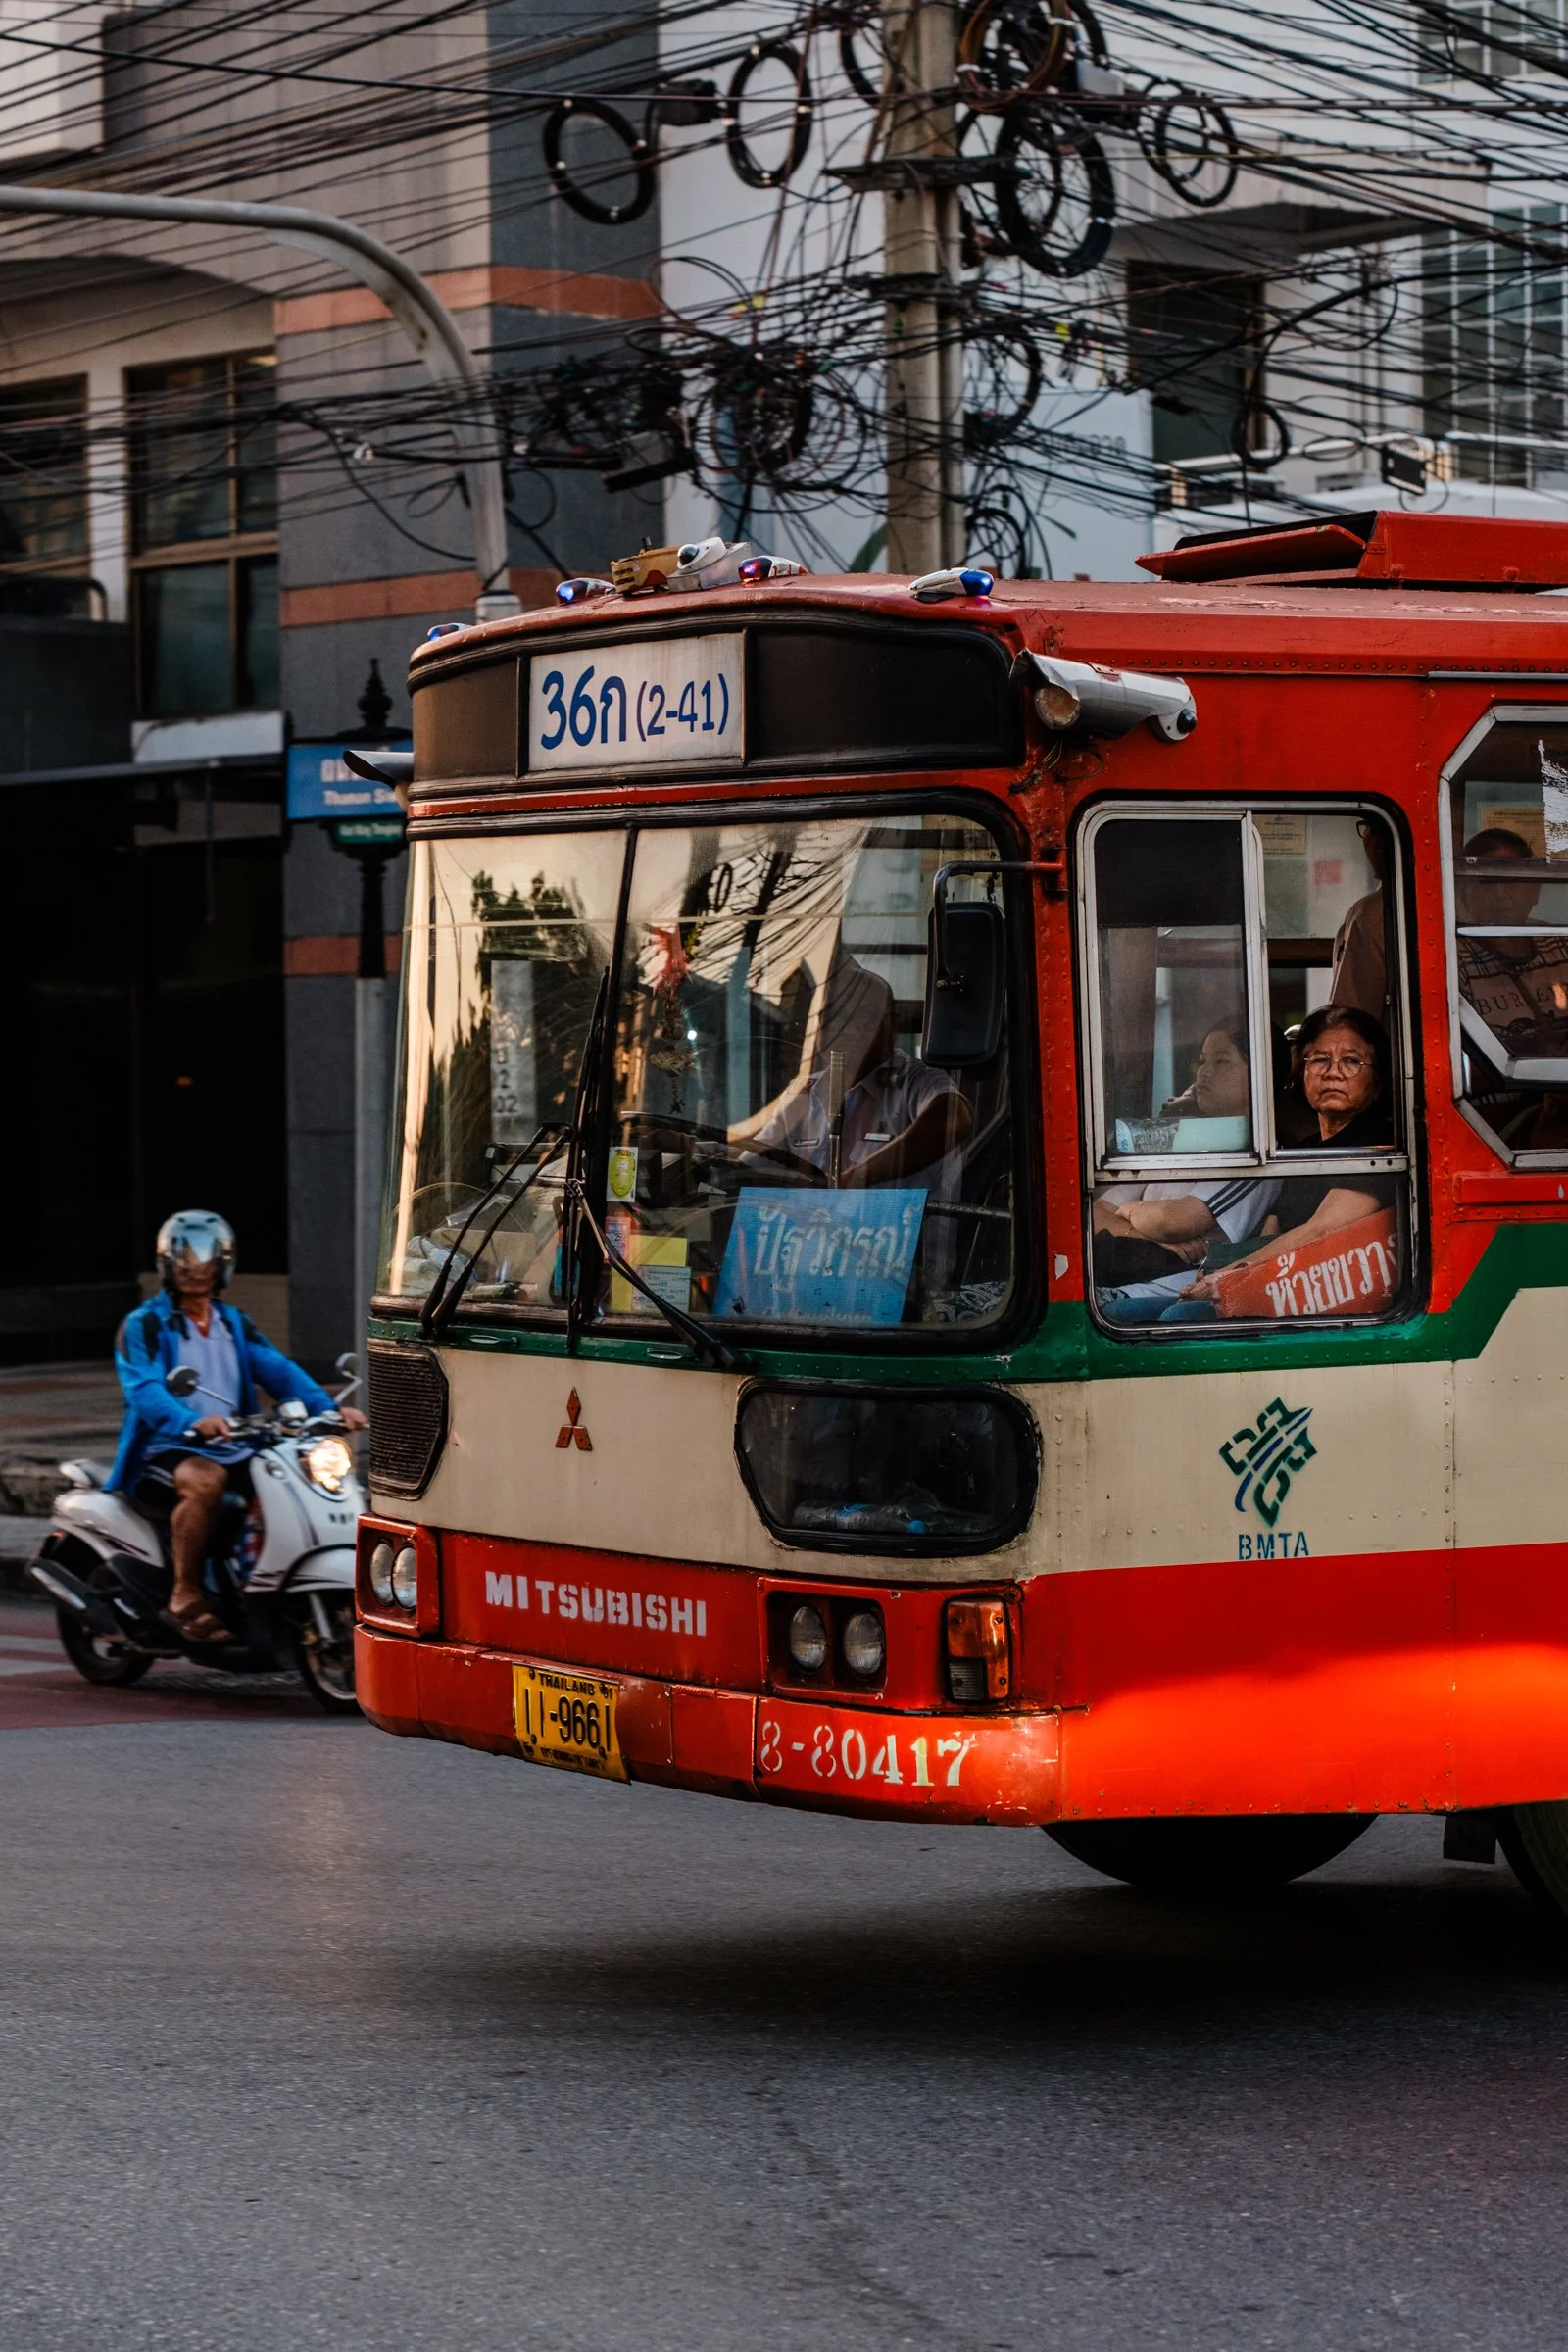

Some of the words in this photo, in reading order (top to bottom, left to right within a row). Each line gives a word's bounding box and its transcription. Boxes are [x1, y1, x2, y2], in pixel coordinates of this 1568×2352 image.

[540, 664, 627, 750] 36ก
[636, 673, 729, 742] (2-41)
[1238, 1531, 1309, 1560] BMTA
[485, 1571, 707, 1637] MITSUBISHI
[538, 1672, 596, 1696] THAILAND
[524, 1688, 612, 1752] 11-9661
[760, 1721, 972, 1787] 8-80417
